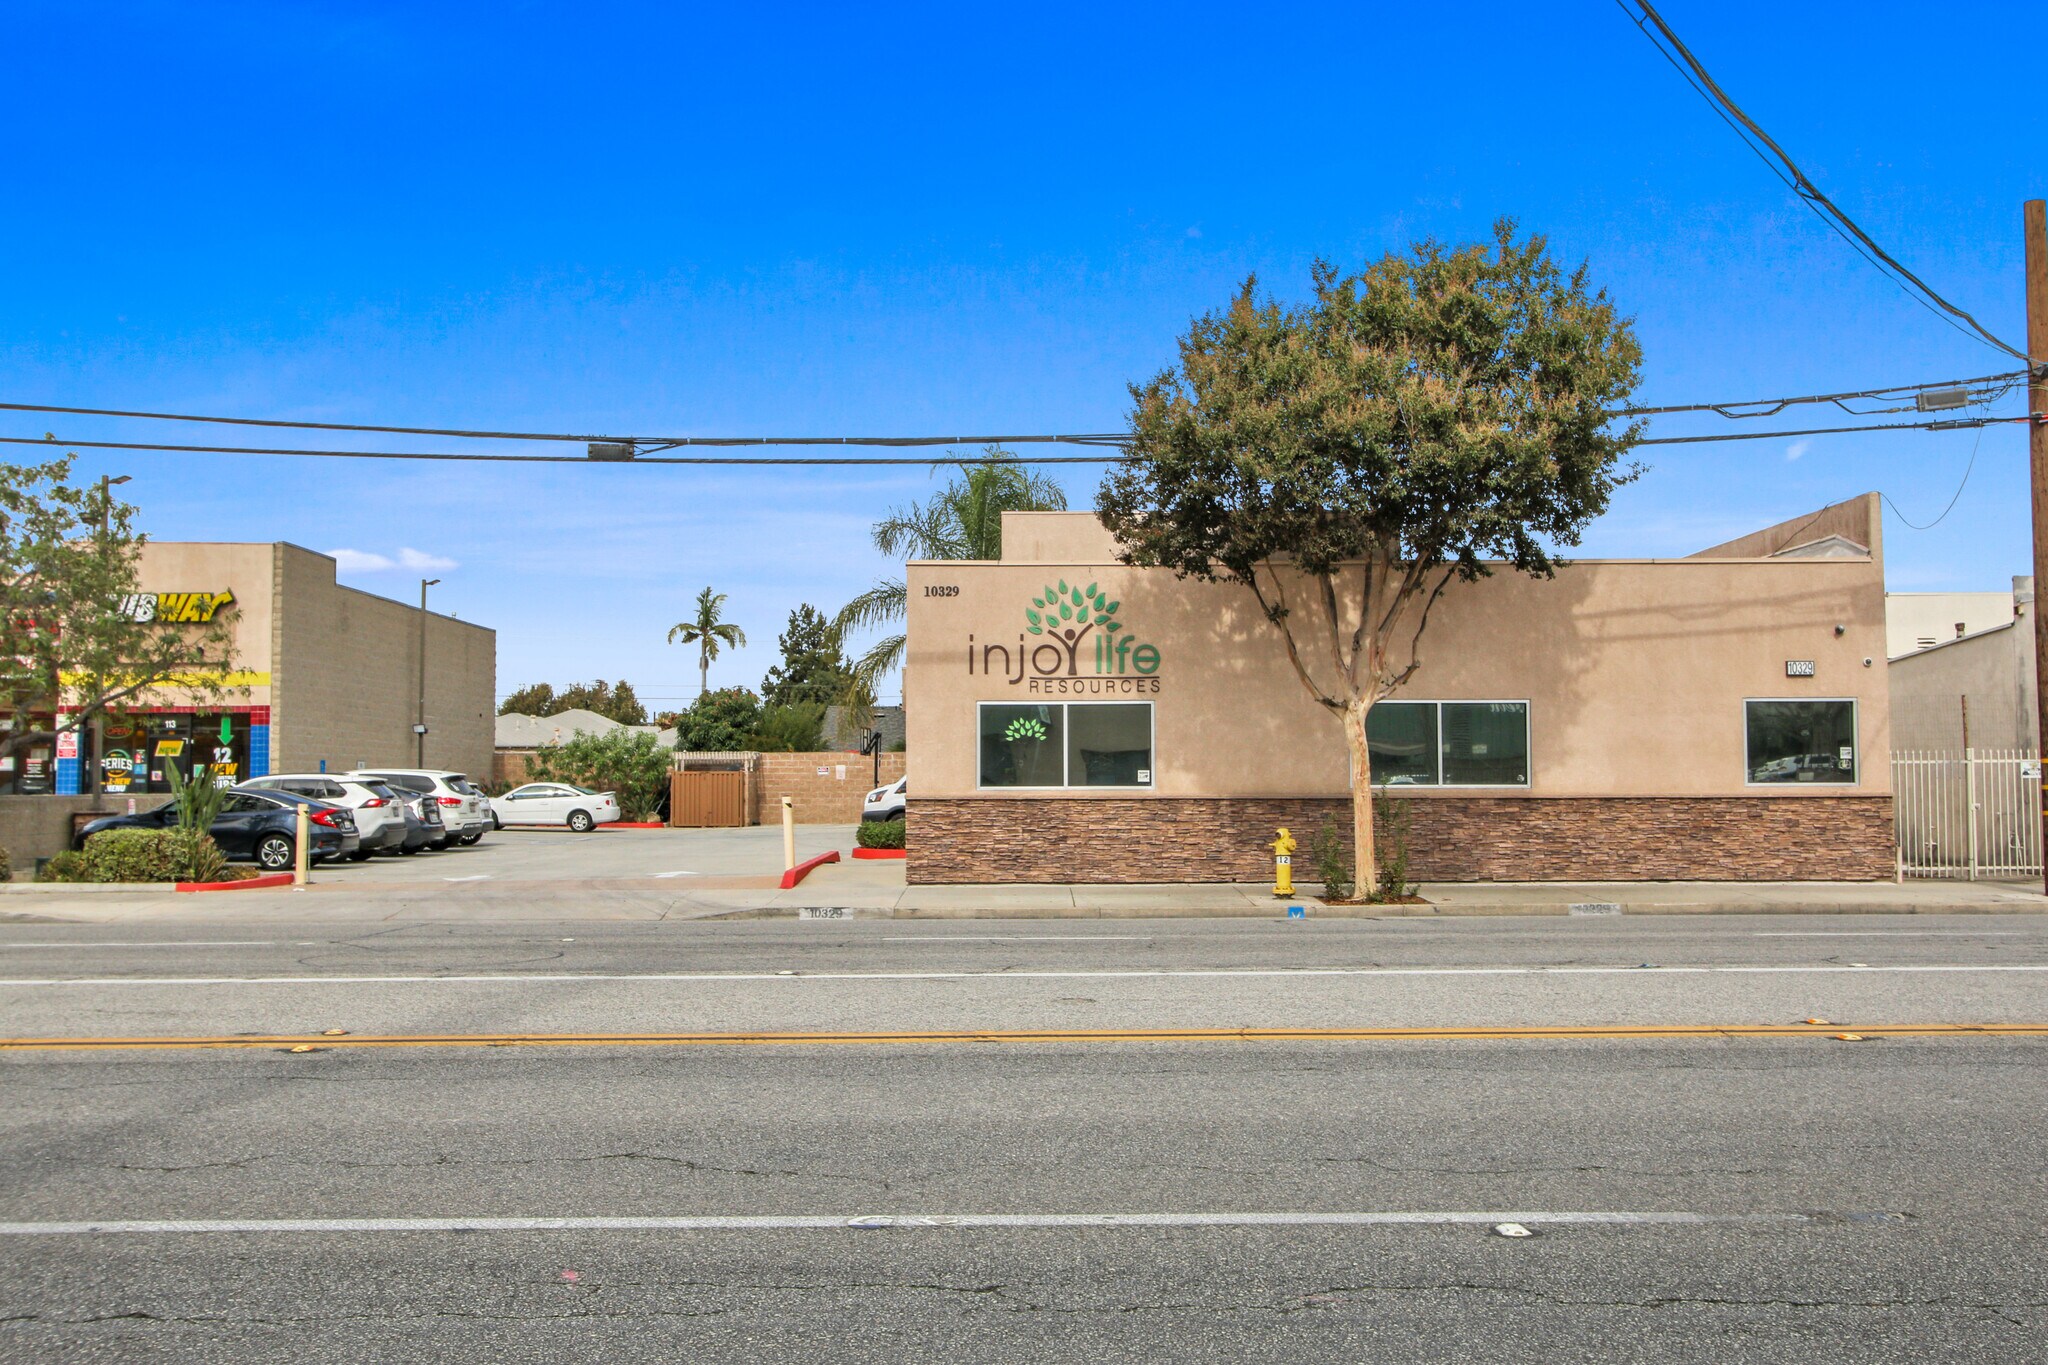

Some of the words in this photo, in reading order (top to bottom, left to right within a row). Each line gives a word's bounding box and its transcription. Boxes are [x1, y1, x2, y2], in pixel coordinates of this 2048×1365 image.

[924, 585, 960, 597] 10329
[106, 591, 236, 623] UBWAY
[1095, 634, 1161, 674] life
[1789, 662, 1813, 674] 10329
[1029, 680, 1161, 694] RESOURCES
[165, 720, 176, 728] 113
[213, 747, 232, 763] 12
[810, 908, 843, 918] 10329
